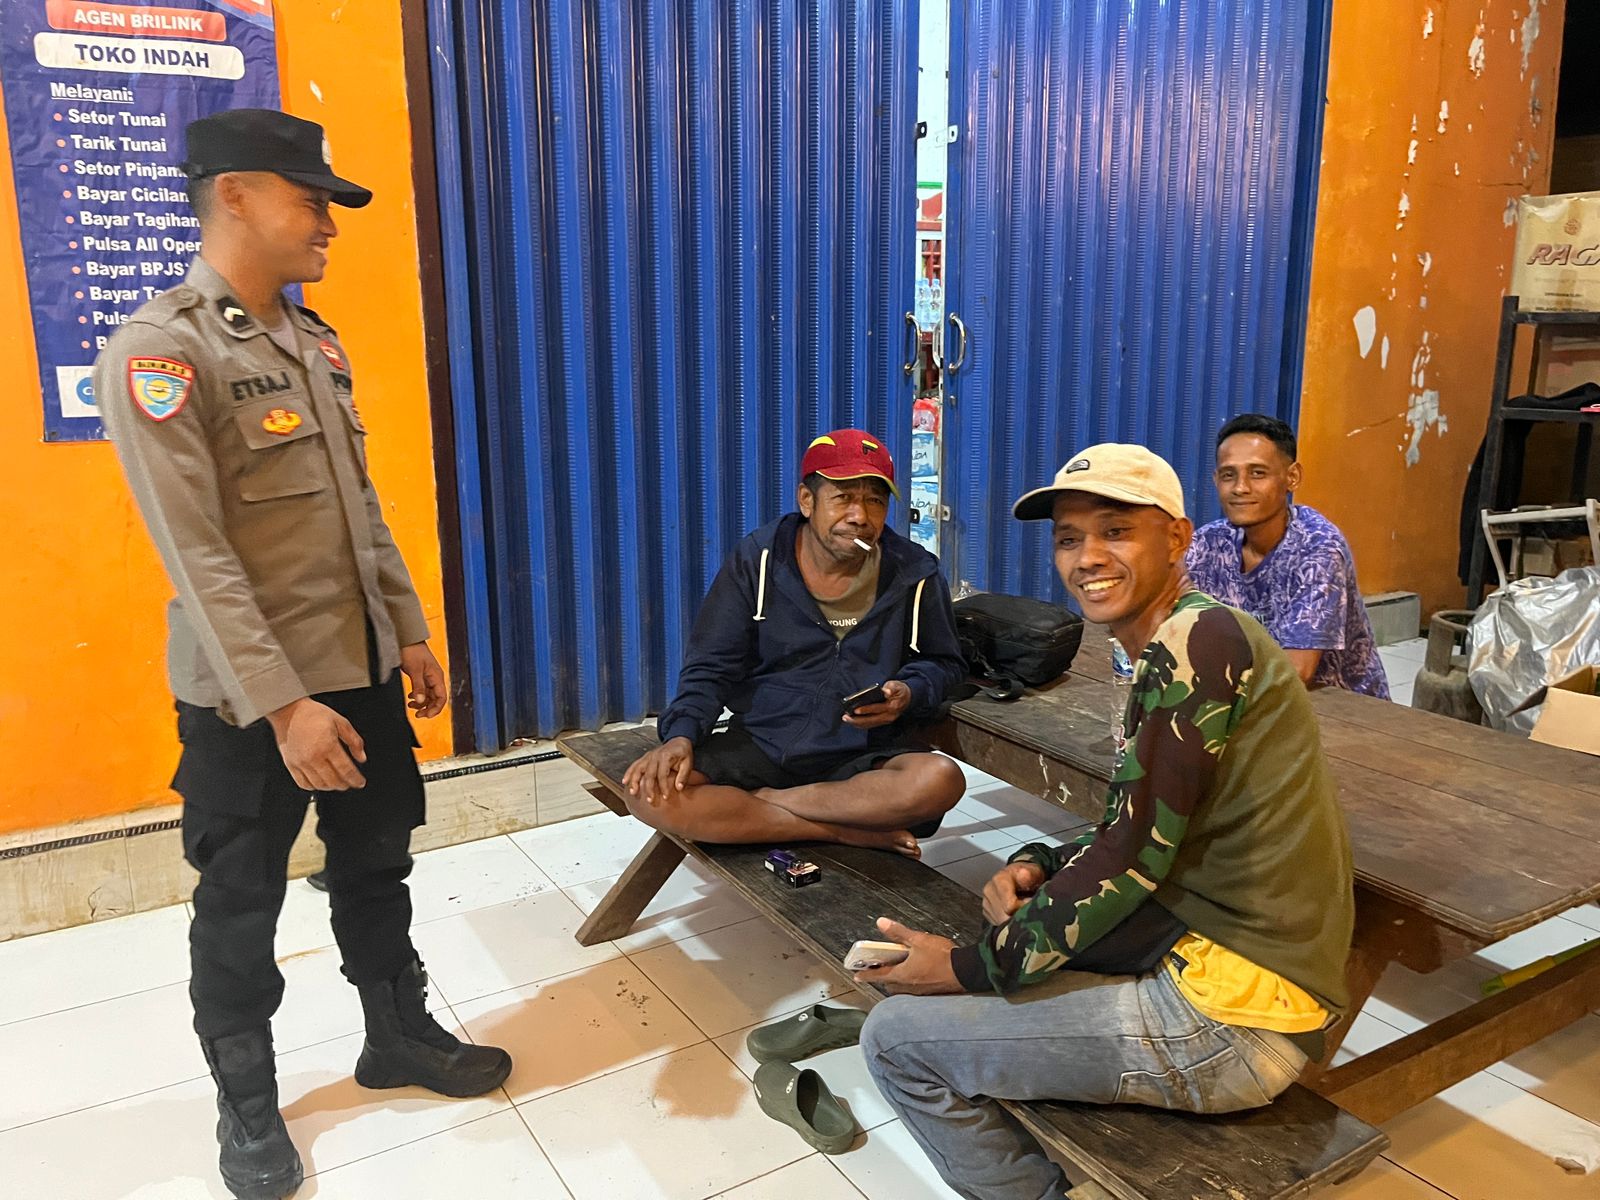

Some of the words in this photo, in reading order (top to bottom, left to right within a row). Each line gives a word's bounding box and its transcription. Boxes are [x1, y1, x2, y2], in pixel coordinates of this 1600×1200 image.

[74, 9, 126, 28] AGEN
[131, 13, 203, 32] BRILINK
[75, 44, 136, 64] TOKO
[144, 48, 210, 68] INDAH
[51, 82, 134, 103] Melayani:
[68, 109, 115, 126] Setor
[119, 112, 167, 127] Tunai
[70, 134, 116, 152] Tarik
[119, 137, 167, 153] Tunai
[74, 160, 121, 177] Setor
[77, 186, 127, 204] Bayar
[80, 210, 130, 230] Bayar
[133, 212, 201, 230] Tagihan
[83, 236, 131, 252] Pulsa
[136, 237, 158, 252] All
[86, 261, 136, 280] Bayar
[140, 262, 189, 276] BPJS
[89, 286, 139, 304] Bayar
[92, 311, 133, 325] Puls
[828, 617, 858, 627] YOUNG
